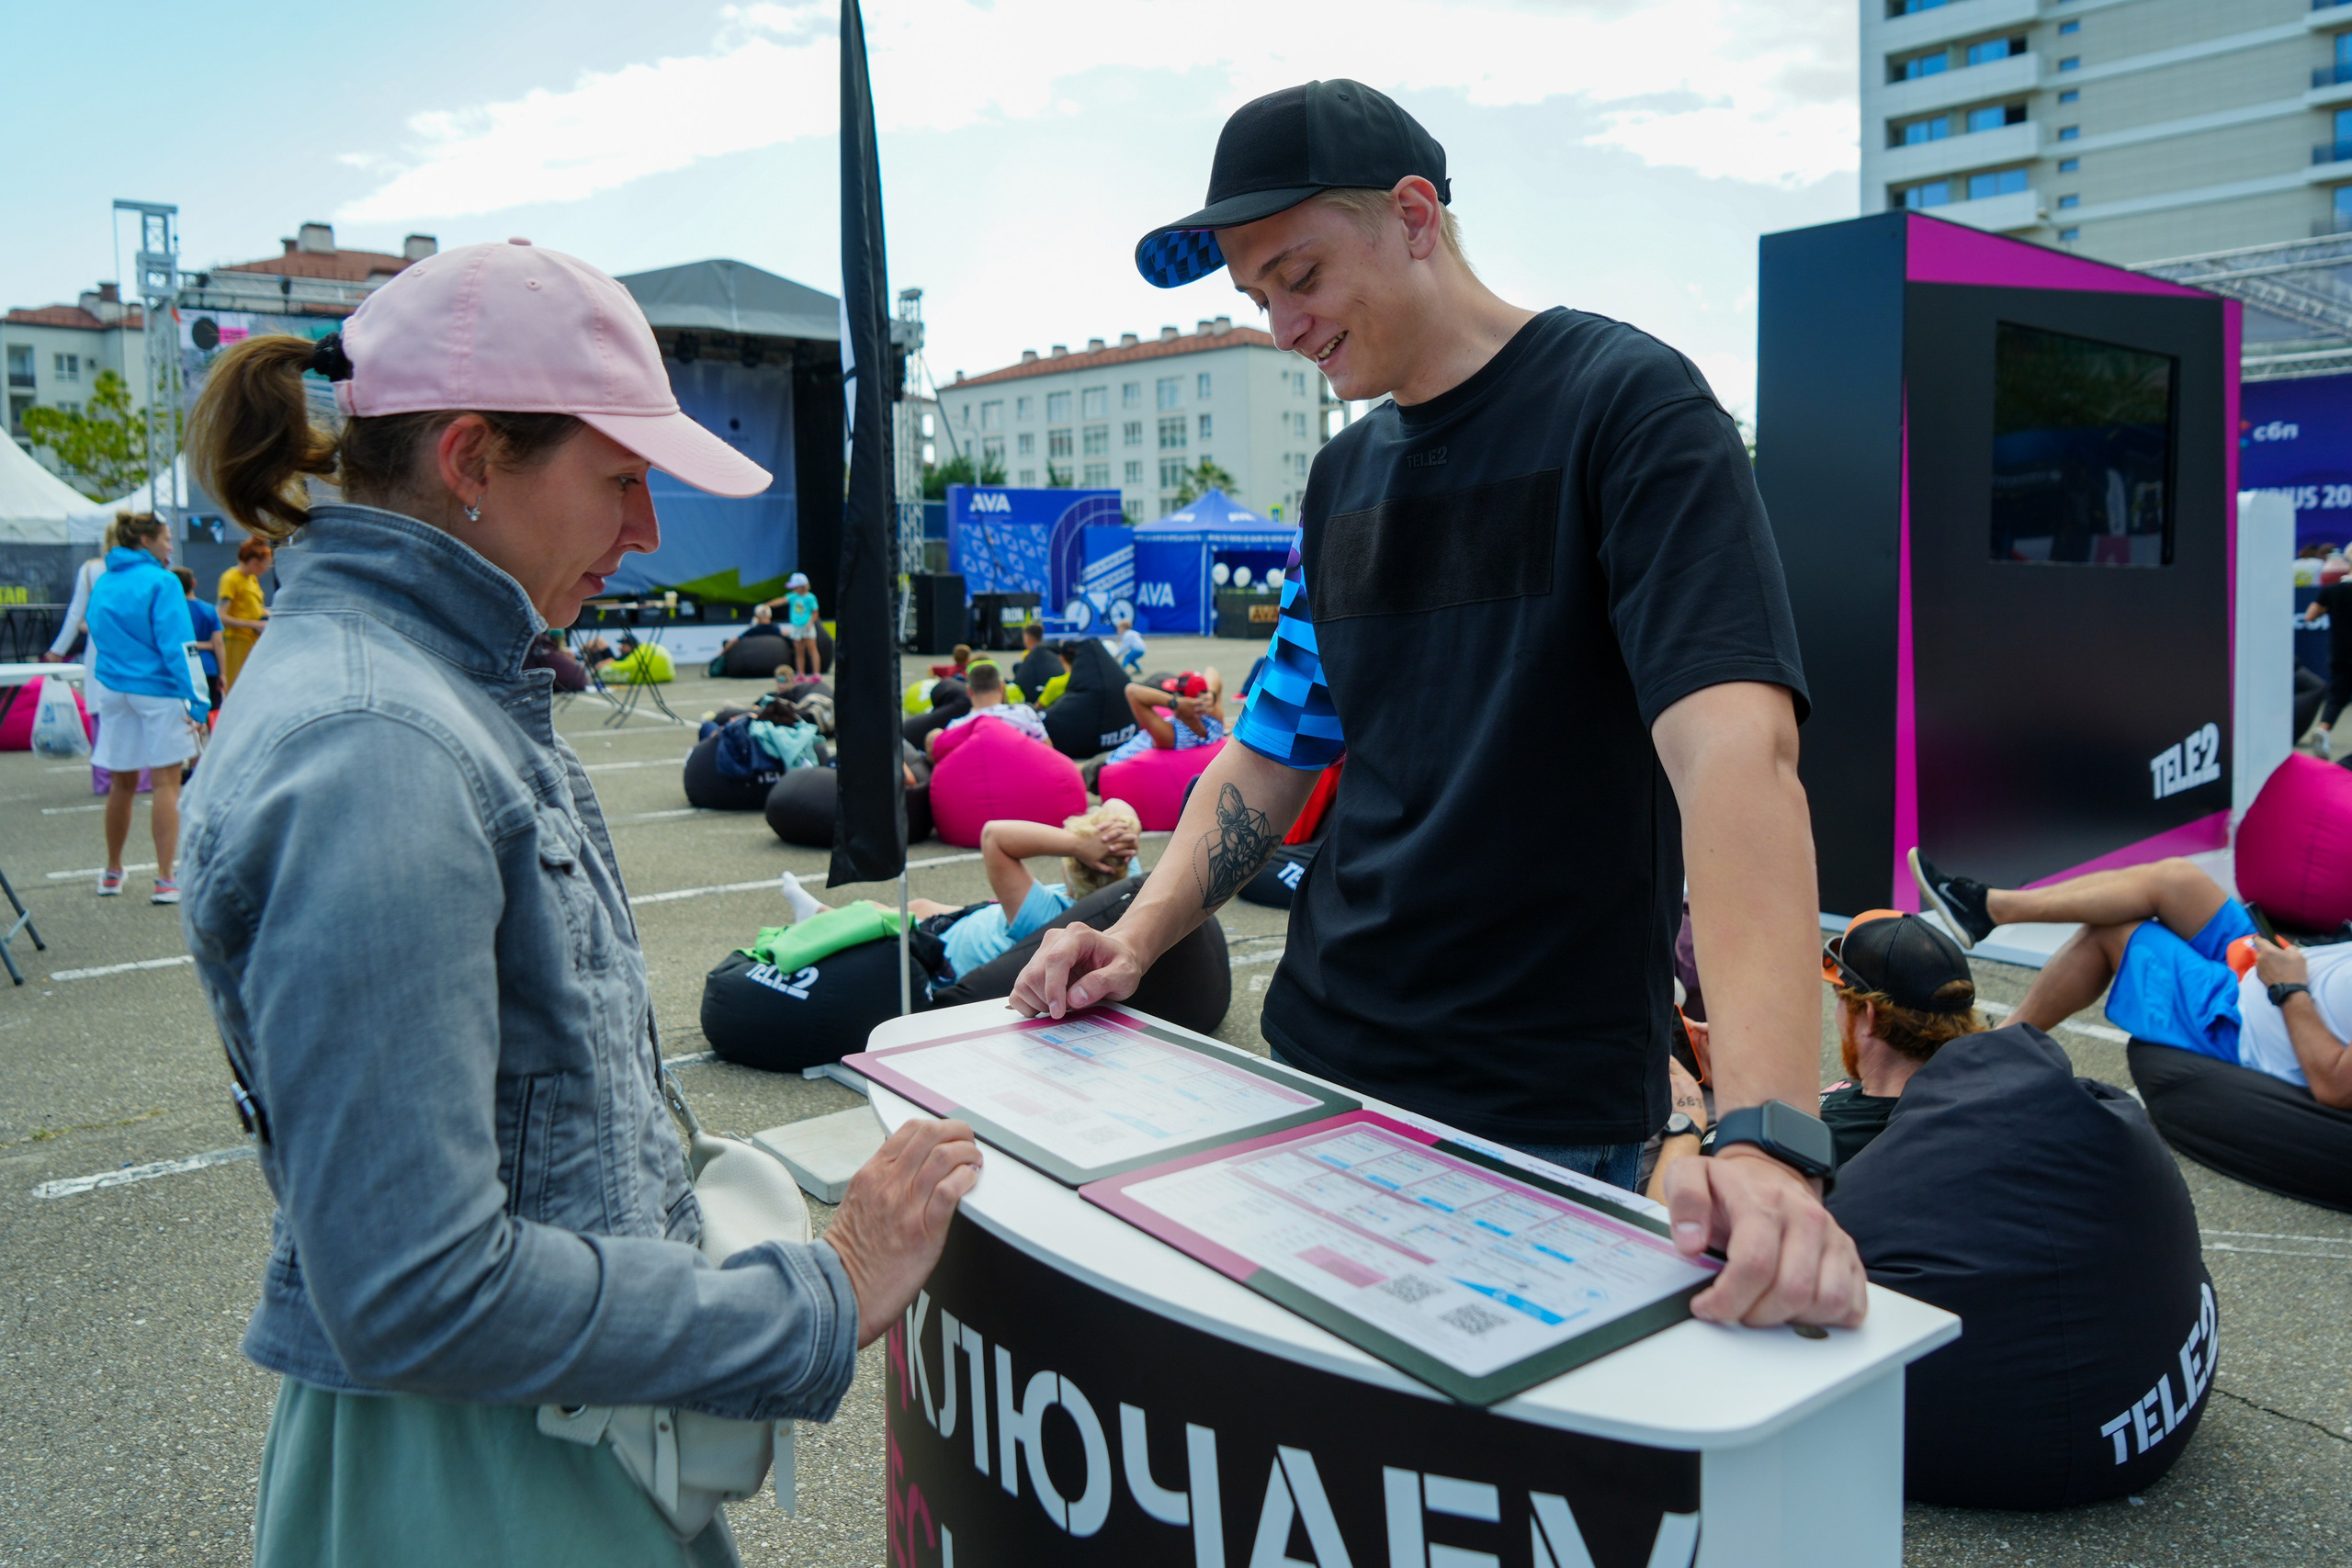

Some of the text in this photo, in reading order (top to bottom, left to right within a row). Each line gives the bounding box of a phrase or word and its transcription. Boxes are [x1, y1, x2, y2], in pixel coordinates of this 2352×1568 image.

[2253, 421, 2299, 443] сбп
[1406, 446, 1448, 468] TELE2
[969, 492, 1012, 513] AVA
[1136, 581, 1176, 607] AVA
[2150, 722, 2222, 800] TELE2
[2099, 1282, 2220, 1466] TELE2
